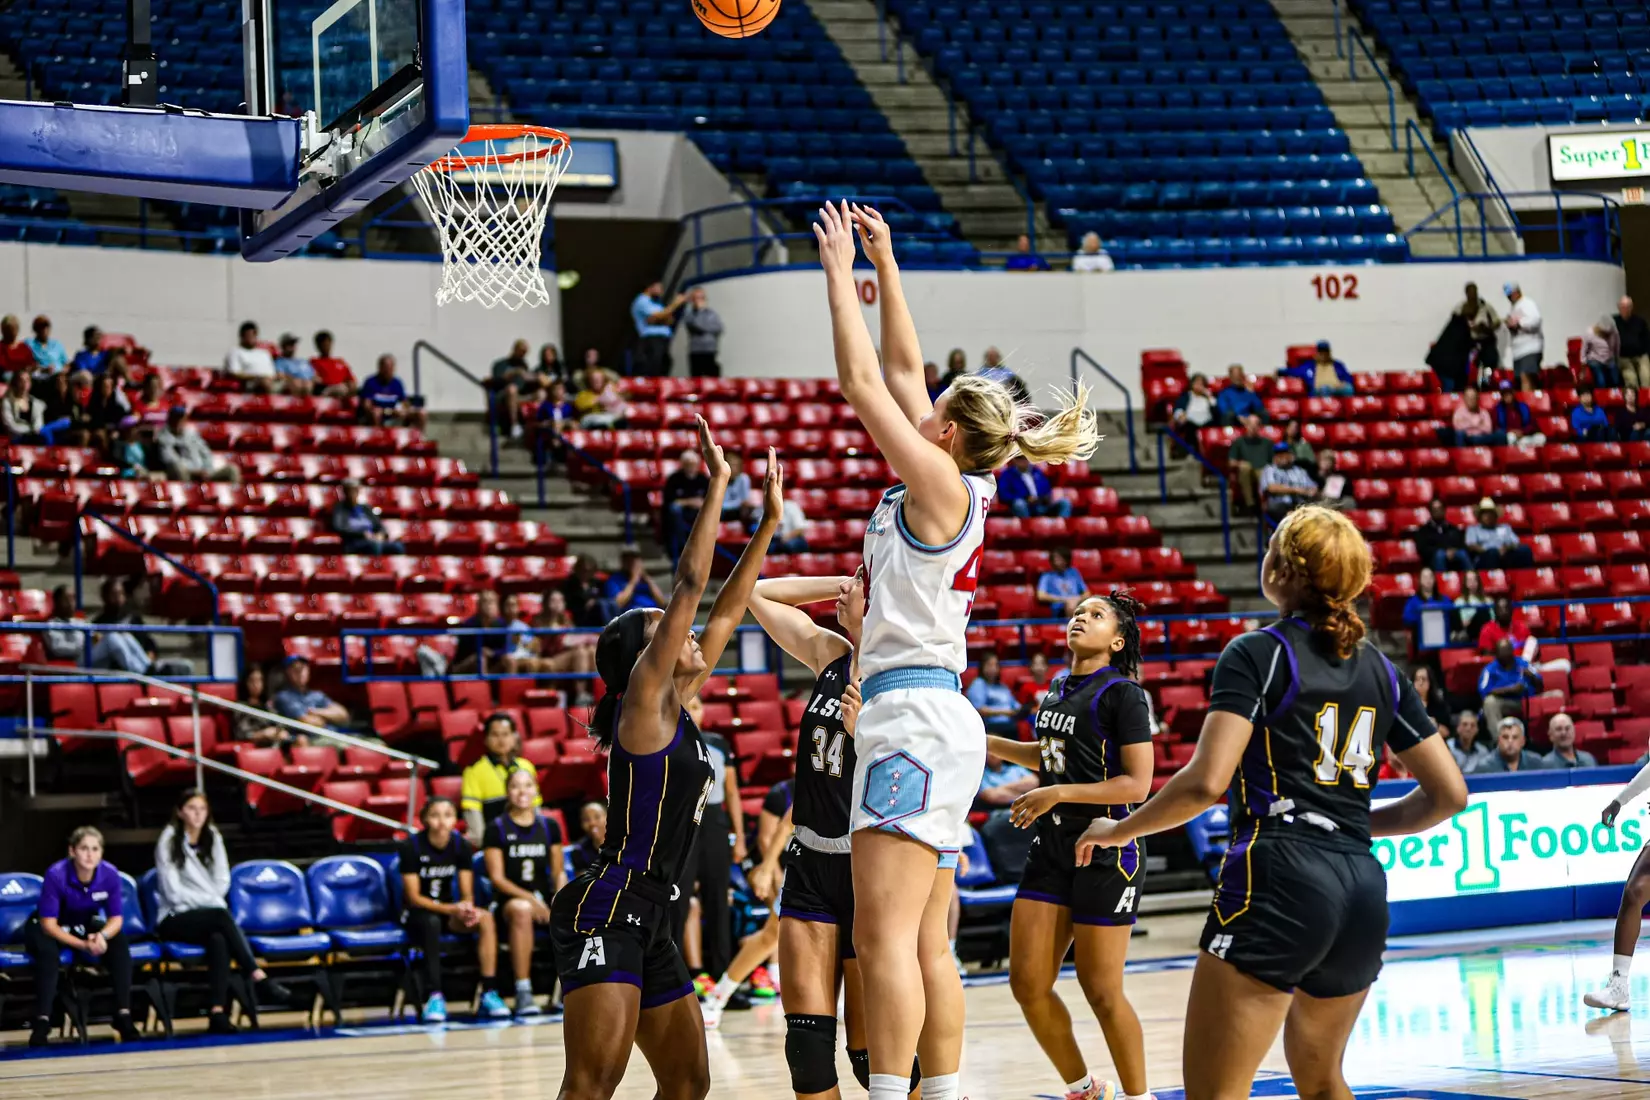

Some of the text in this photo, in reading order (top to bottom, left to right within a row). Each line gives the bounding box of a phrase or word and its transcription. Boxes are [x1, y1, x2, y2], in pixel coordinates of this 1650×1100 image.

[1560, 144, 1619, 168] Super
[1621, 138, 1642, 170] 1
[1311, 272, 1360, 301] 102
[810, 725, 847, 778] 34
[1312, 702, 1377, 789] 14
[1452, 801, 1500, 892] 1
[1498, 811, 1643, 862] Foods
